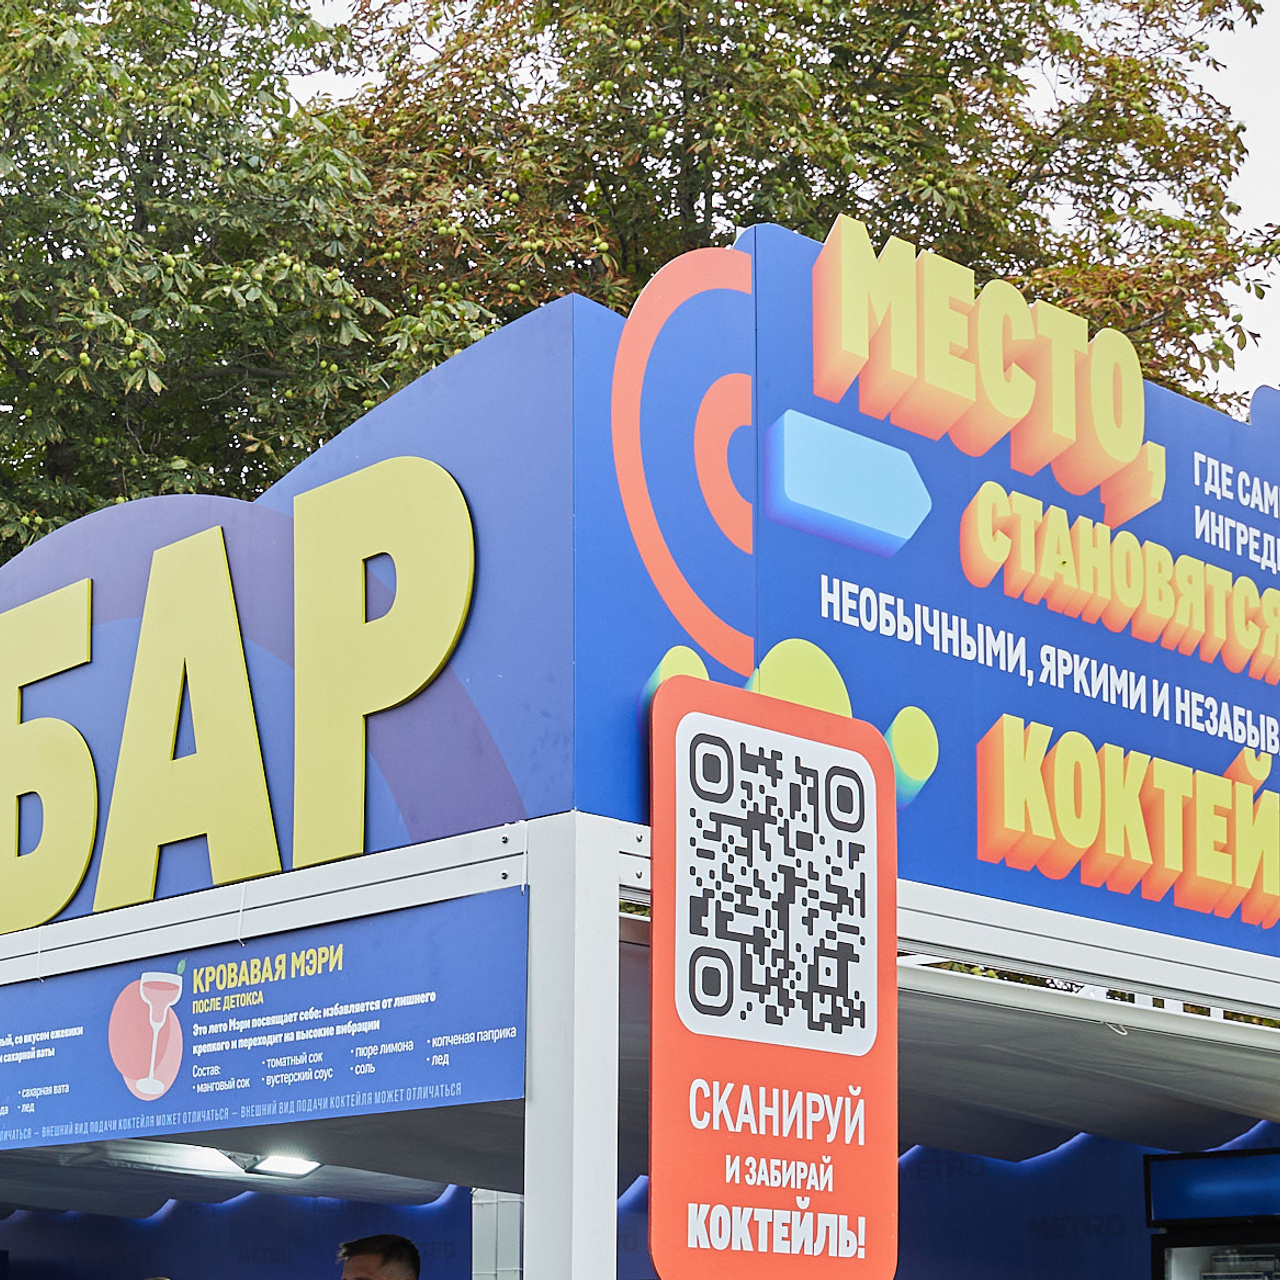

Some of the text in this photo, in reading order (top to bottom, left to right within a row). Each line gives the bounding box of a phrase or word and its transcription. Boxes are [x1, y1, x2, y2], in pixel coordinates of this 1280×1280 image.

[820, 213, 1166, 520] МЕСТО,
[1194, 451, 1280, 519] ГДЕ САМ
[1195, 505, 1280, 575] ИНГРЕД
[965, 480, 1280, 675] СТАНОВЯТСЯ
[821, 574, 1034, 687] НЕОБЫЧНЫМИ,
[1039, 645, 1147, 718] ЯРКИМИ
[1152, 679, 1170, 723] И
[193, 944, 344, 994] КРОВАВАЯ МЭРИ
[193, 991, 264, 1014] ПОСЛЕ ДЕТОКСА
[193, 991, 436, 1037] Это лето Мэри посвящает себе: избавляется от лишнего
[193, 1019, 380, 1057] крепкого и переходит на высокие вибрации
[355, 1040, 414, 1059] пюре лимона
[432, 1024, 516, 1048] копченая паприка
[193, 1065, 221, 1078] Состав:
[266, 1052, 323, 1068] томатный сок
[266, 1067, 333, 1088] вустерский соус
[355, 1064, 375, 1076] соль
[432, 1052, 449, 1066] лед
[22, 1084, 70, 1099] сахарная вата
[197, 1077, 250, 1093] манговый сок
[22, 1104, 34, 1114] лед
[119, 1113, 154, 1130] КОКТЕЙЛЯ
[156, 1112, 180, 1126] МОЖЕТ
[183, 1107, 228, 1123] ОТЛИЧАТЬСЯ
[241, 1100, 276, 1118] ВНЕШНИЙ
[280, 1100, 294, 1115] ВИД
[297, 1097, 328, 1113] ПОДАЧИ
[330, 1090, 372, 1108] КОКТЕЙЛЯ
[375, 1089, 404, 1104] МОЖЕТ
[407, 1082, 462, 1101] ОТЛИЧАТЬСЯ
[689, 1078, 865, 1146] СКАНИРУЙ
[725, 1154, 834, 1192] И ЗАБИРАЙ
[687, 1196, 866, 1259] КОКТЕЙЛЬ!
